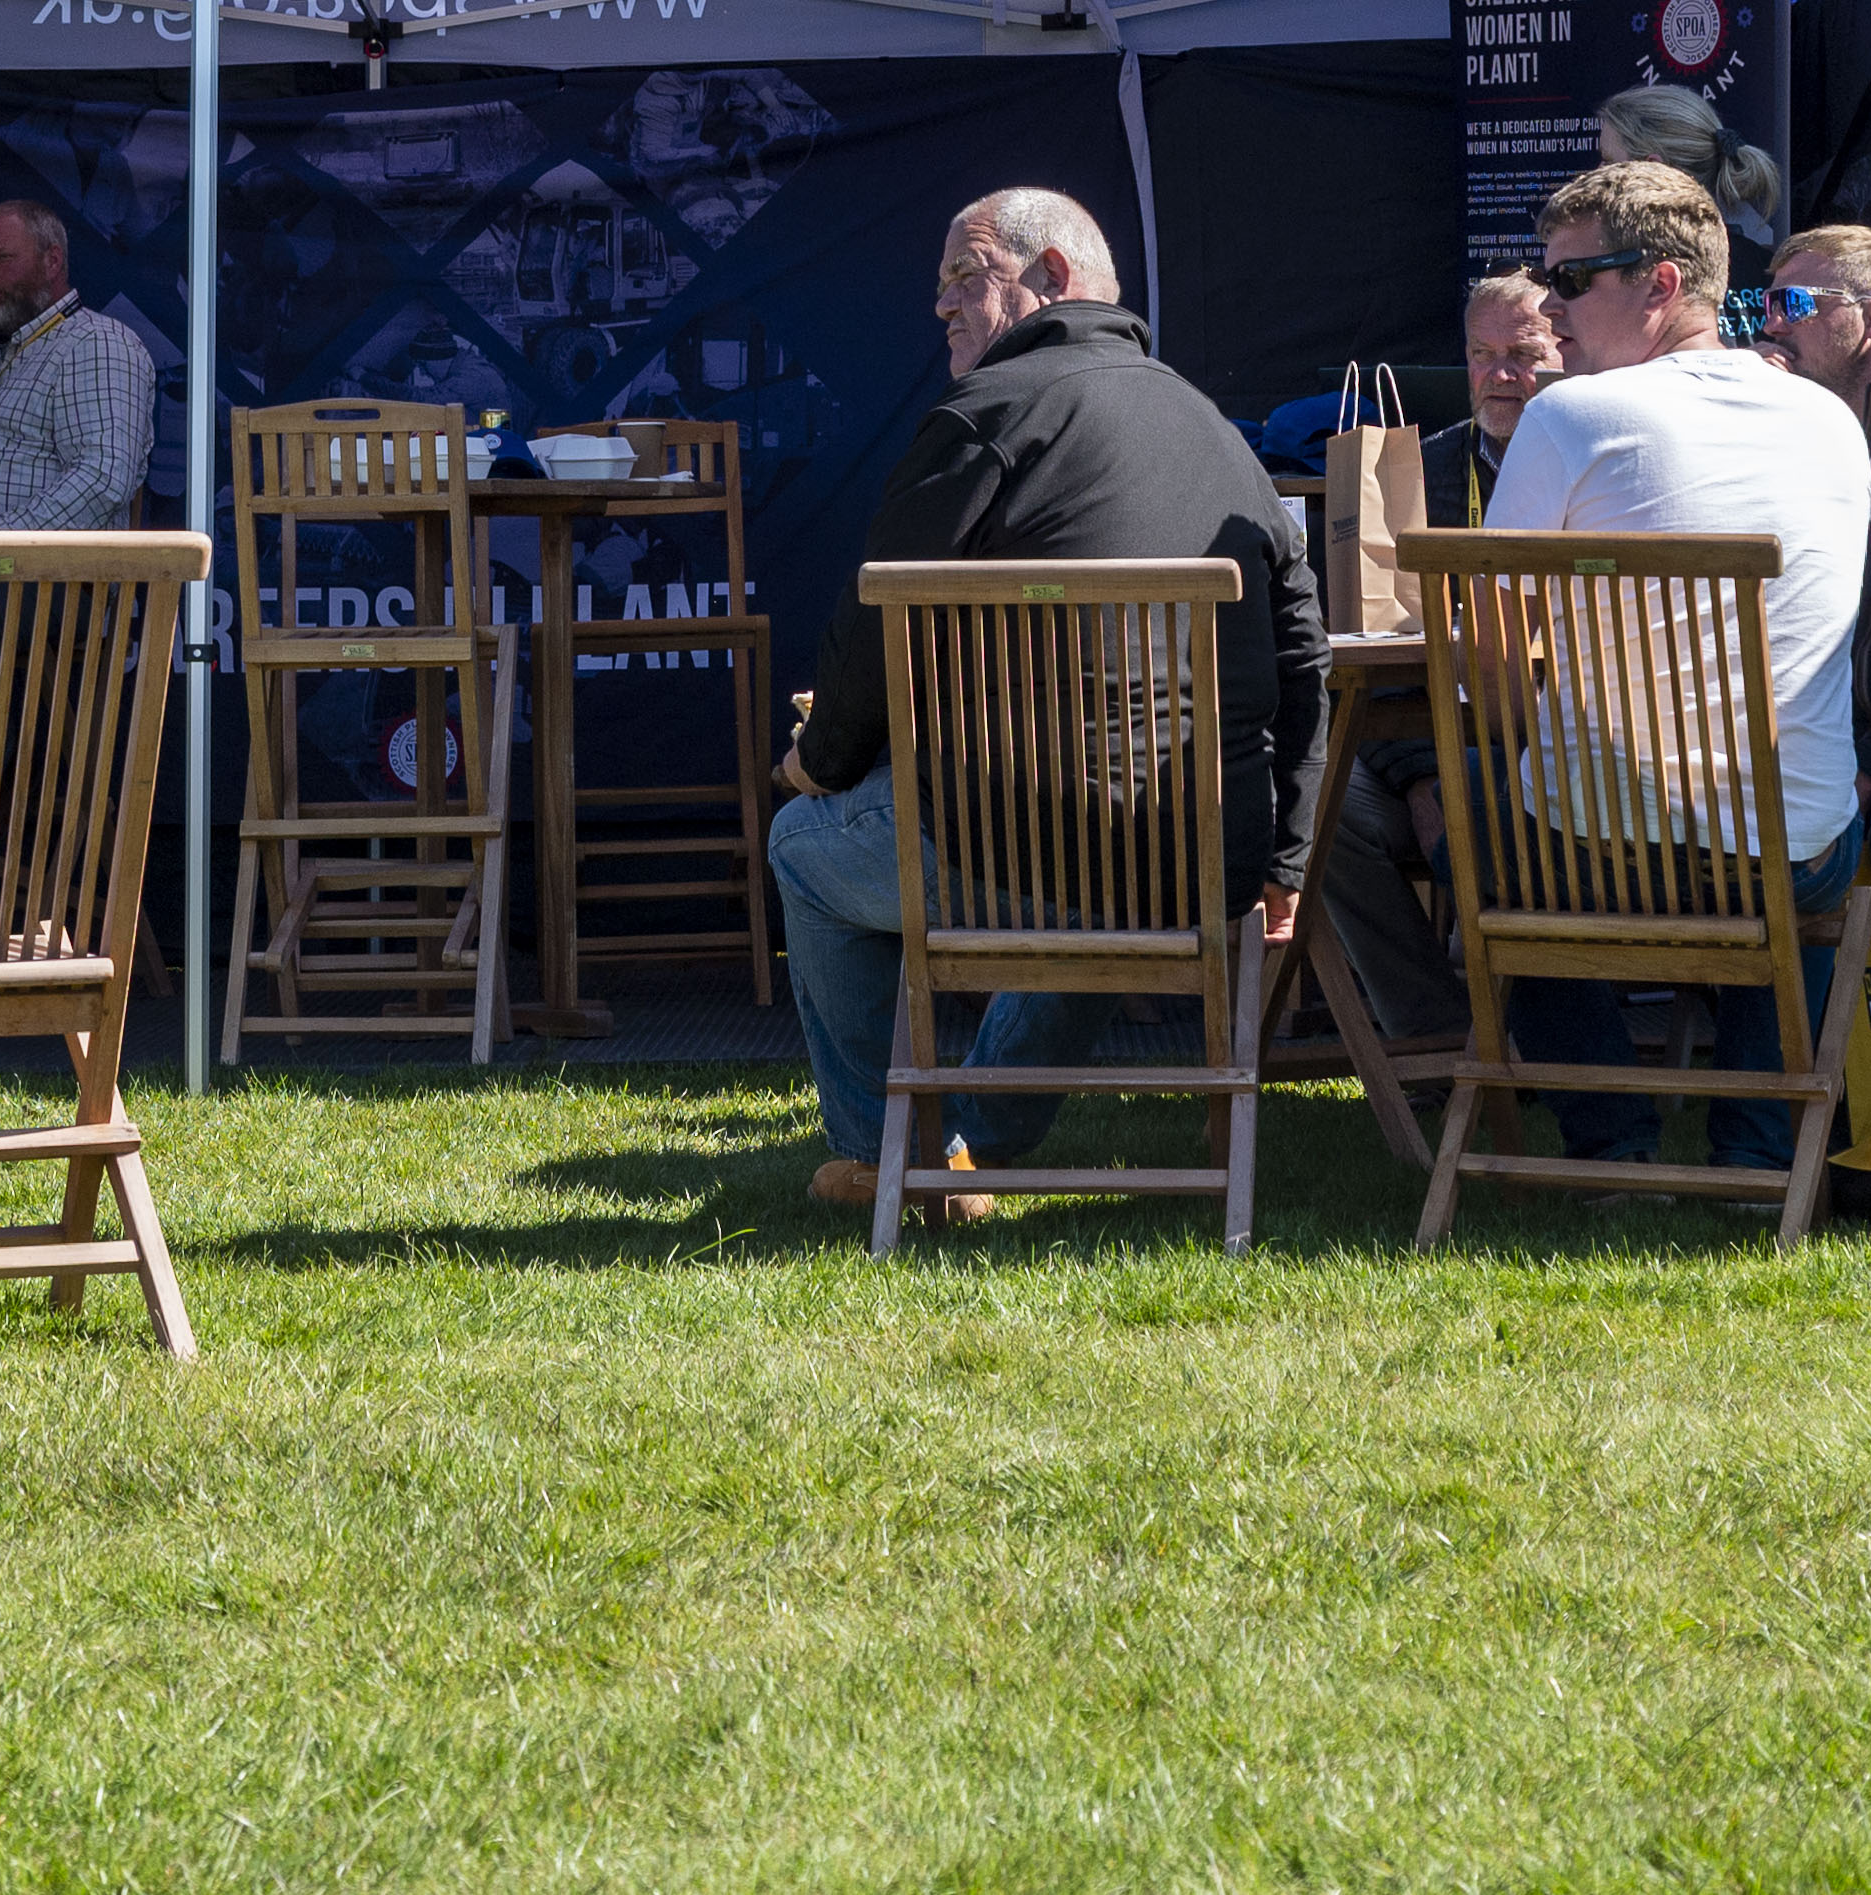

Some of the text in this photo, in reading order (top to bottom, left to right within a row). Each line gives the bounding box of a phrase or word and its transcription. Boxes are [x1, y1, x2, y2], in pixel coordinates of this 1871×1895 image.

[1465, 10, 1571, 46] WOMEN IN
[1663, 4, 1676, 53] SCOTTISH
[1676, 15, 1706, 38] SPOA
[1466, 52, 1539, 86] PLANT!
[1466, 122, 1492, 136] WE'RE
[1494, 121, 1501, 134] A
[1502, 119, 1551, 134] DEDICATED
[1553, 118, 1580, 132] GROUP
[1466, 141, 1497, 155] WOMEN
[1499, 140, 1509, 154] IN
[1511, 138, 1565, 154] SCOTLAND'S
[1566, 137, 1594, 151] PLANT
[1467, 171, 1493, 180] Whether
[1515, 170, 1541, 179] seeking
[1543, 170, 1550, 178] to
[1515, 182, 1542, 192] needing
[1494, 195, 1522, 203] connect
[1467, 208, 1478, 217] you
[1487, 208, 1498, 216] get
[1468, 235, 1497, 245] EXCLUSIVE
[1479, 248, 1500, 258] EVENTS
[1502, 247, 1510, 257] ON
[1512, 247, 1523, 257] ALL
[1524, 246, 1540, 257] YEAR
